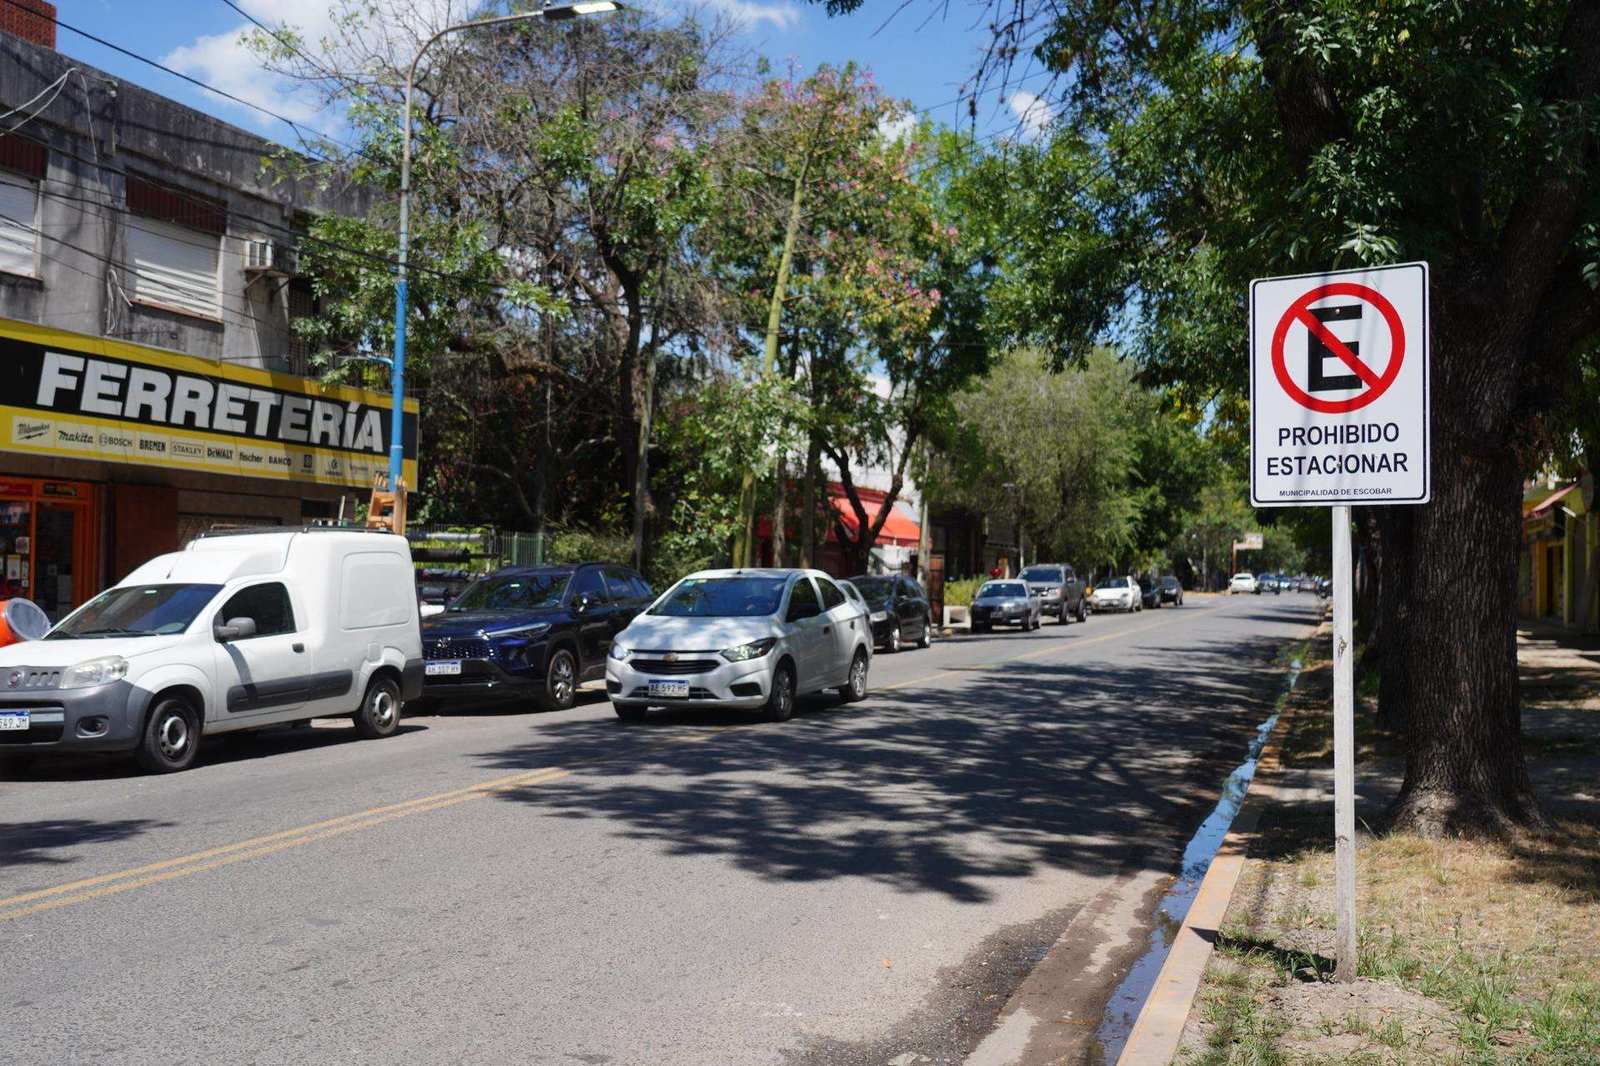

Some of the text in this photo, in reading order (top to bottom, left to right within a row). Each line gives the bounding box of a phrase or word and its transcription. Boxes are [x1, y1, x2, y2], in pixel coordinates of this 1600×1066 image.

[36, 351, 384, 453] FERRETERÍA
[1278, 422, 1400, 447] PROHIBIDO
[107, 436, 134, 447] BOSCH
[139, 439, 166, 452] BREMEN
[239, 451, 264, 463] fischer
[1267, 452, 1408, 476] ESTACIONAR
[1279, 487, 1392, 497] MUNICIPALIDAD DE ESCOBAR
